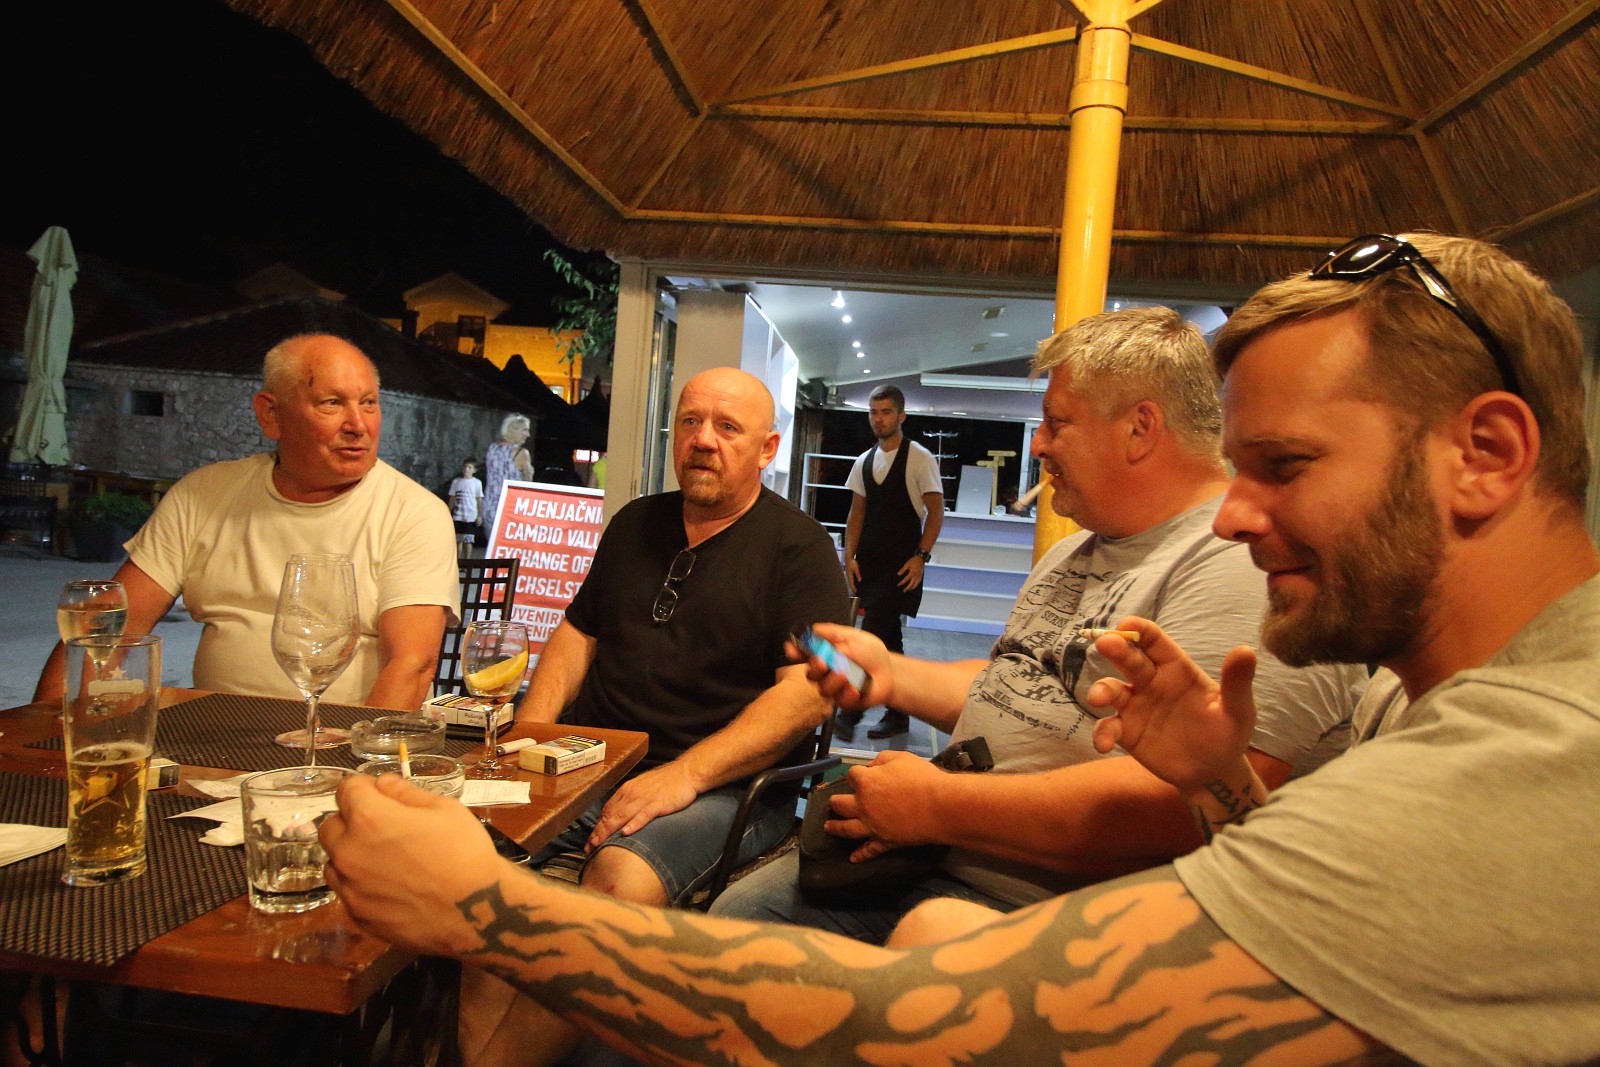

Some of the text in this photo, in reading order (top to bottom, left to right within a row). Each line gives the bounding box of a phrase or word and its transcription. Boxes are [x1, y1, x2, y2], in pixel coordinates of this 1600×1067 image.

[514, 497, 602, 525] MJENJAČNI
[505, 521, 563, 546] CAMBIO
[495, 545, 594, 575] EXCHANGE OF
